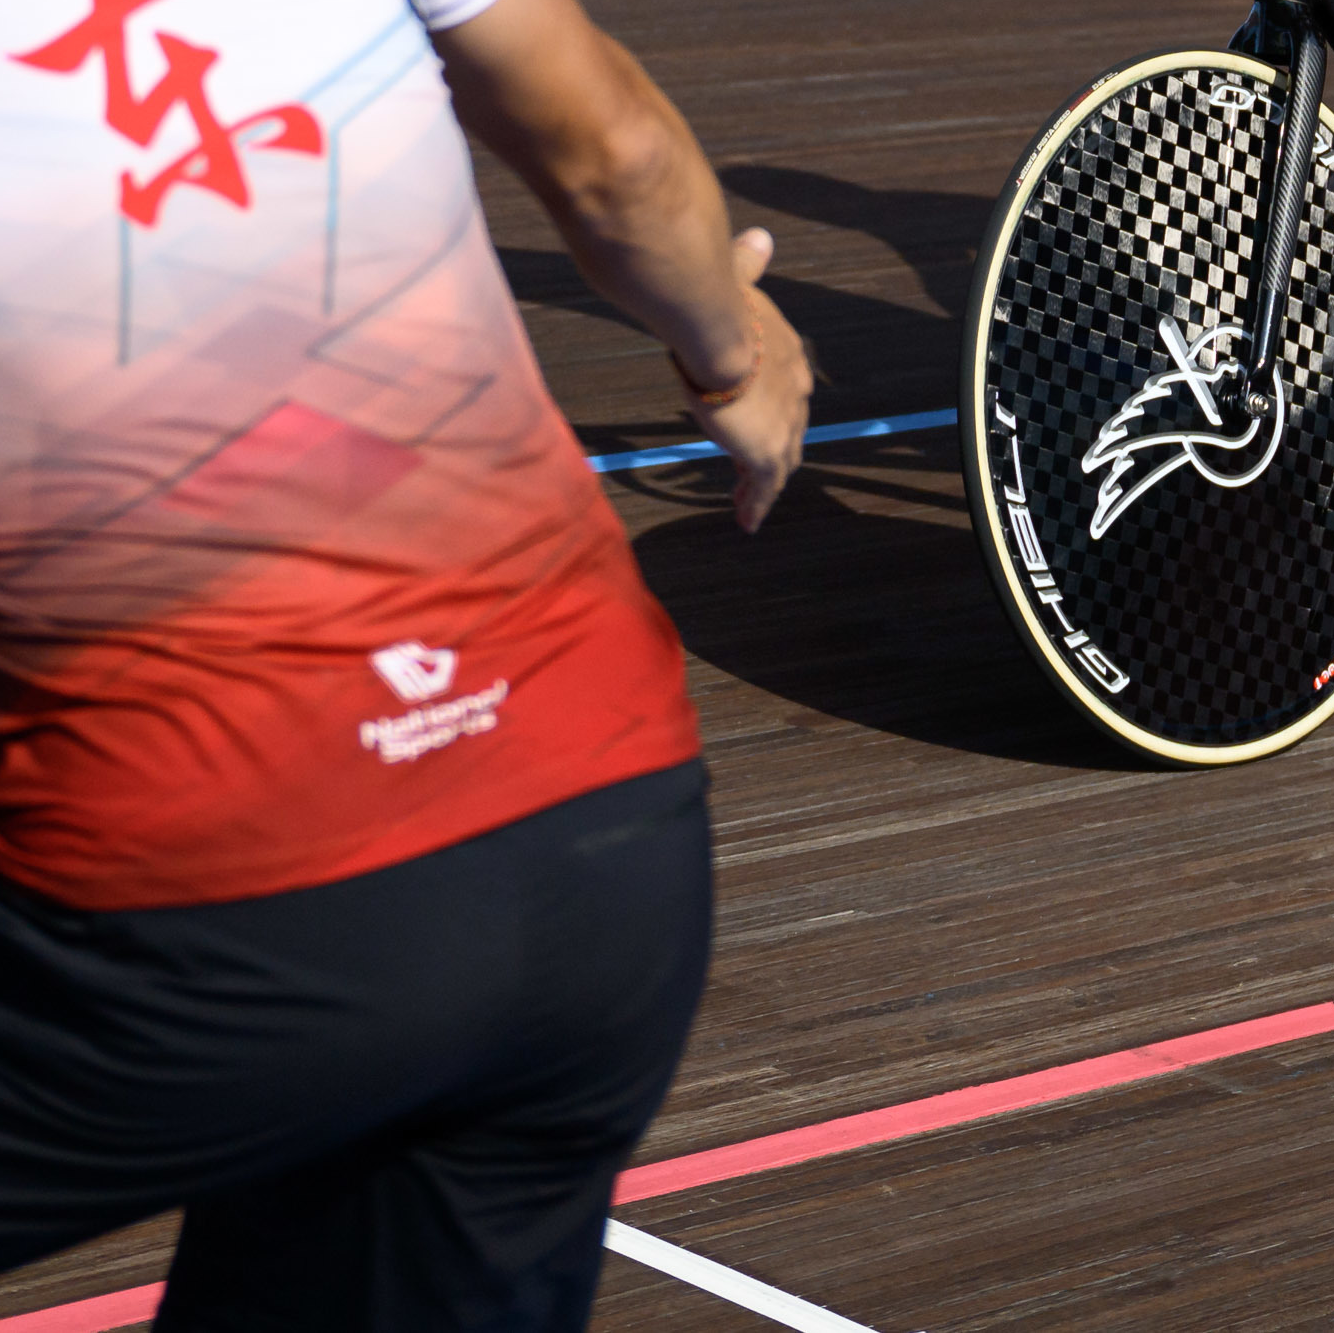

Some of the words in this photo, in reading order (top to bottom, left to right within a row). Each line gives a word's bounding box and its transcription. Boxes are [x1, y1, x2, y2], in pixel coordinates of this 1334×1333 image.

[1036, 128, 1056, 152] PISTA
[1052, 109, 1072, 130] SPEED
[995, 399, 1131, 695] GHIBLI
[359, 677, 509, 752] National
